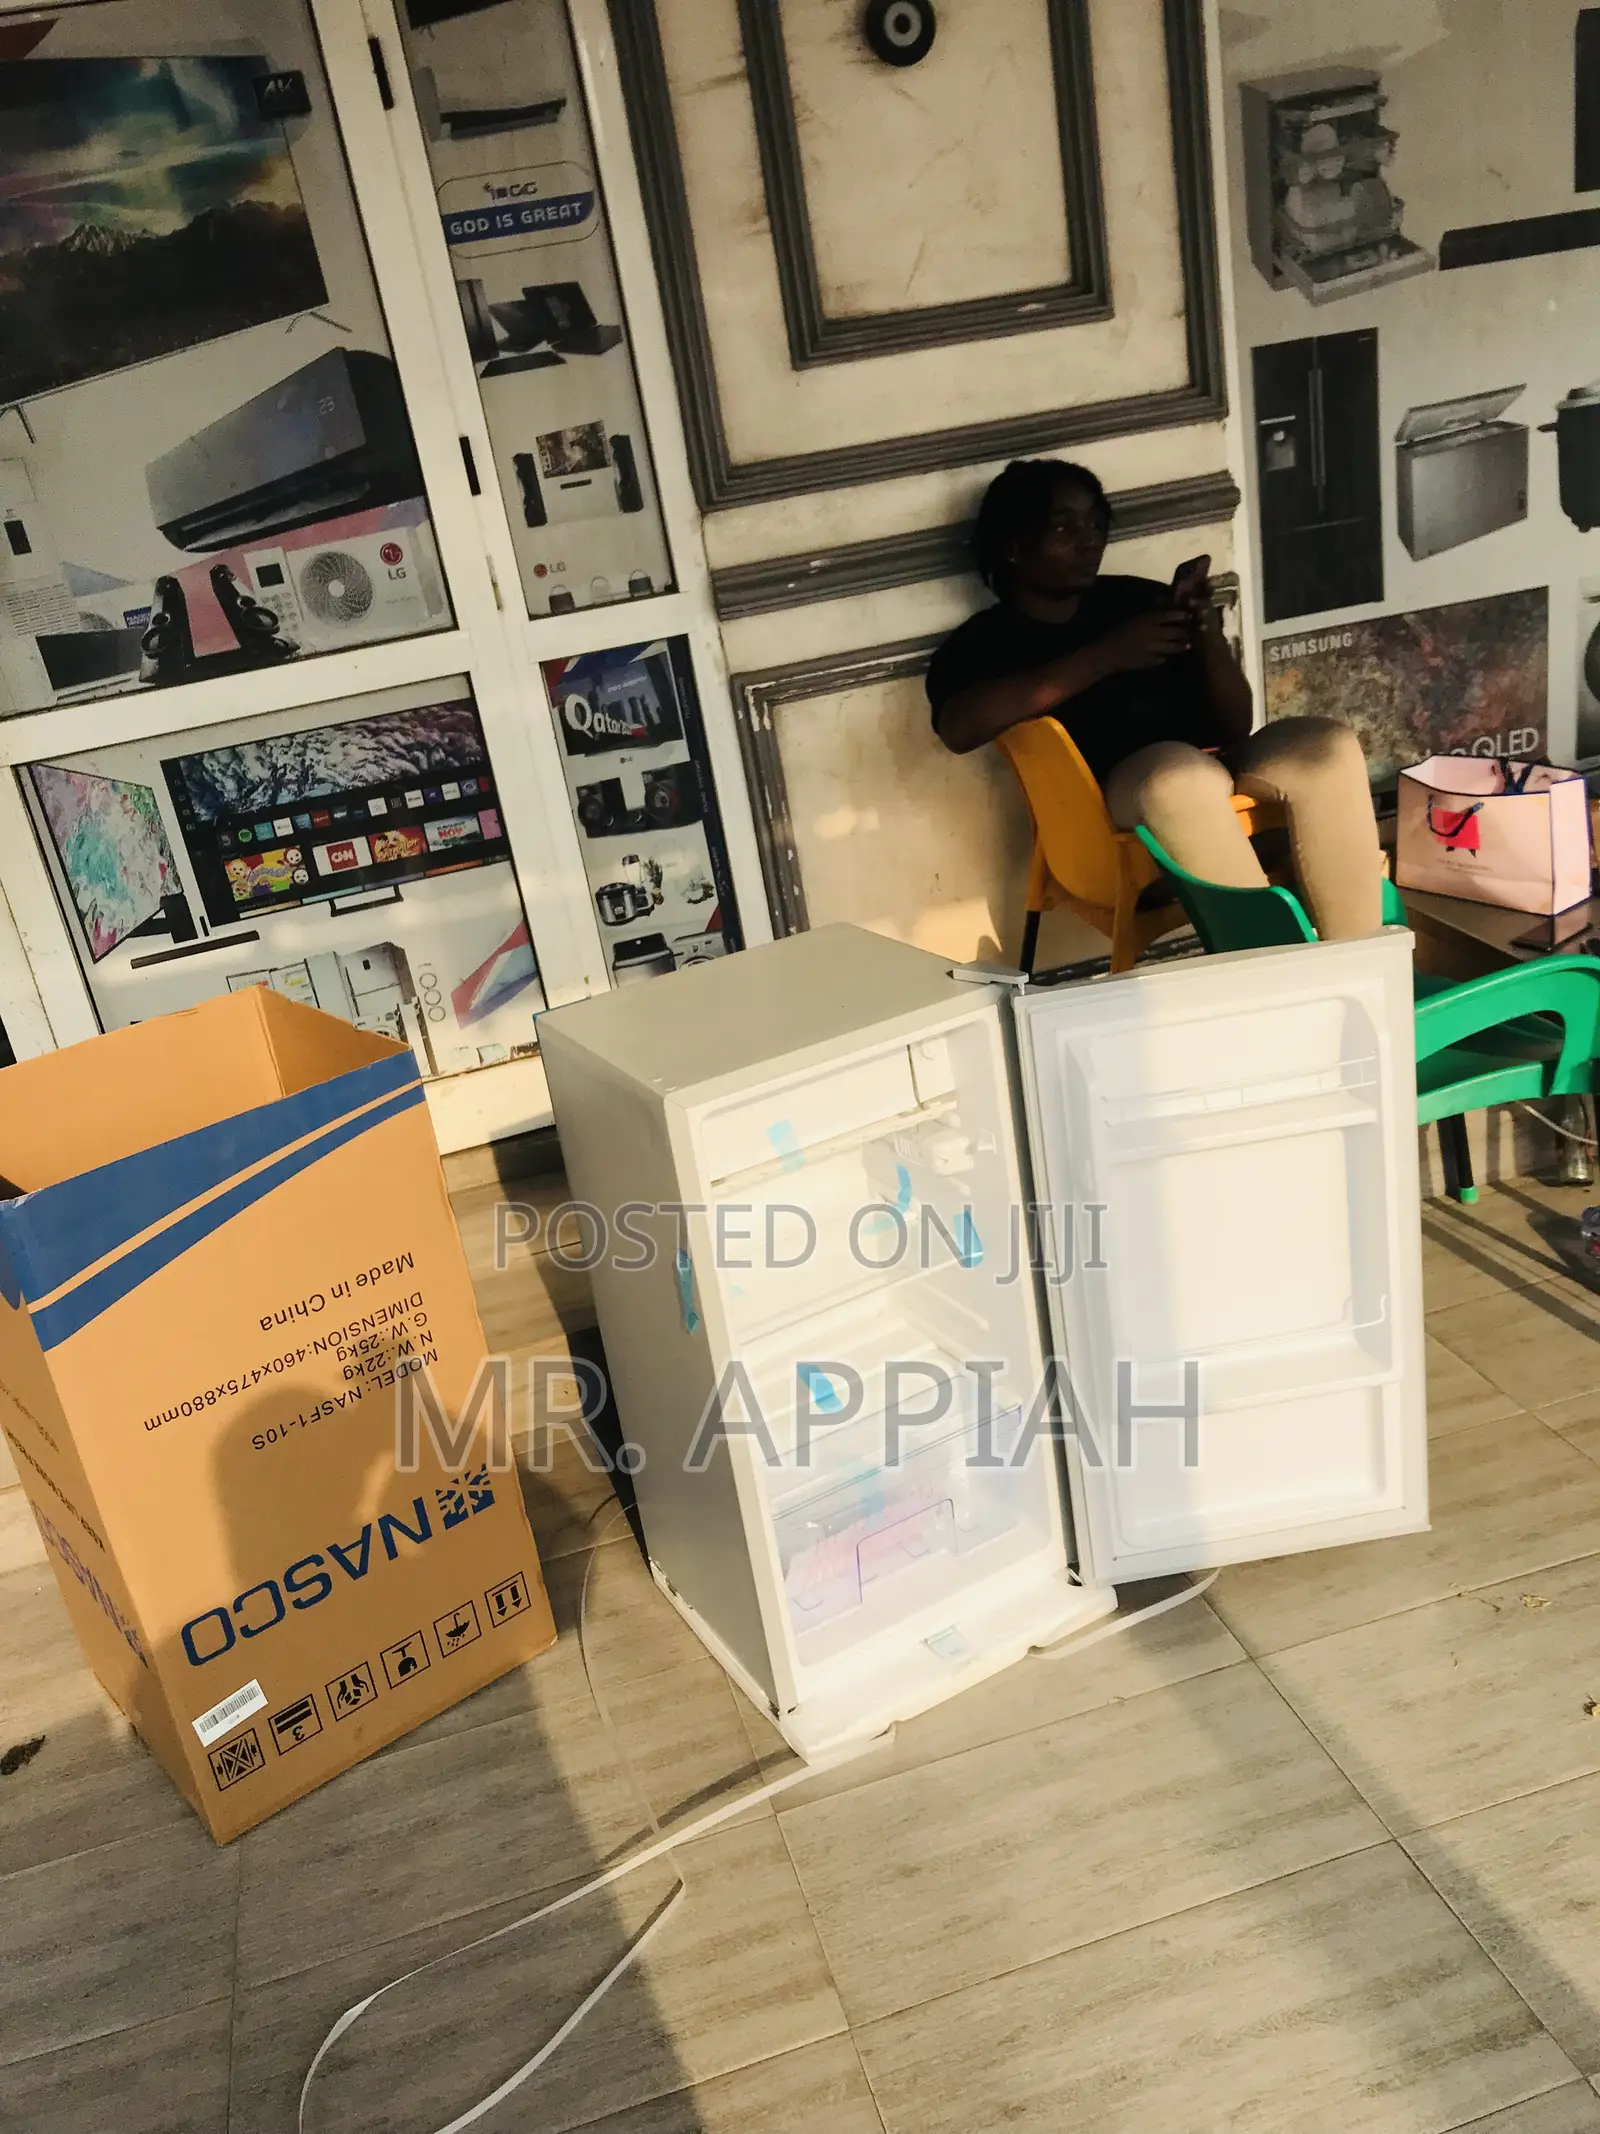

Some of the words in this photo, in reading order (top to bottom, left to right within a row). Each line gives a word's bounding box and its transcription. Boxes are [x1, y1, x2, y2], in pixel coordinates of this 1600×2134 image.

[450, 218, 490, 236] GOD
[496, 213, 514, 229] IS
[520, 202, 583, 225] GREAT
[388, 567, 407, 580] LG
[549, 561, 567, 574] LG
[1269, 632, 1354, 662] SAMSUNG
[1471, 727, 1540, 758] QLED
[331, 848, 354, 864] CNN
[355, 1251, 416, 1288] Made
[331, 1281, 352, 1299] in
[259, 1293, 327, 1332] China
[367, 1347, 439, 1393] MODEL:
[251, 1386, 363, 1451] NASF1-10S
[180, 1497, 433, 1667] NASCO
